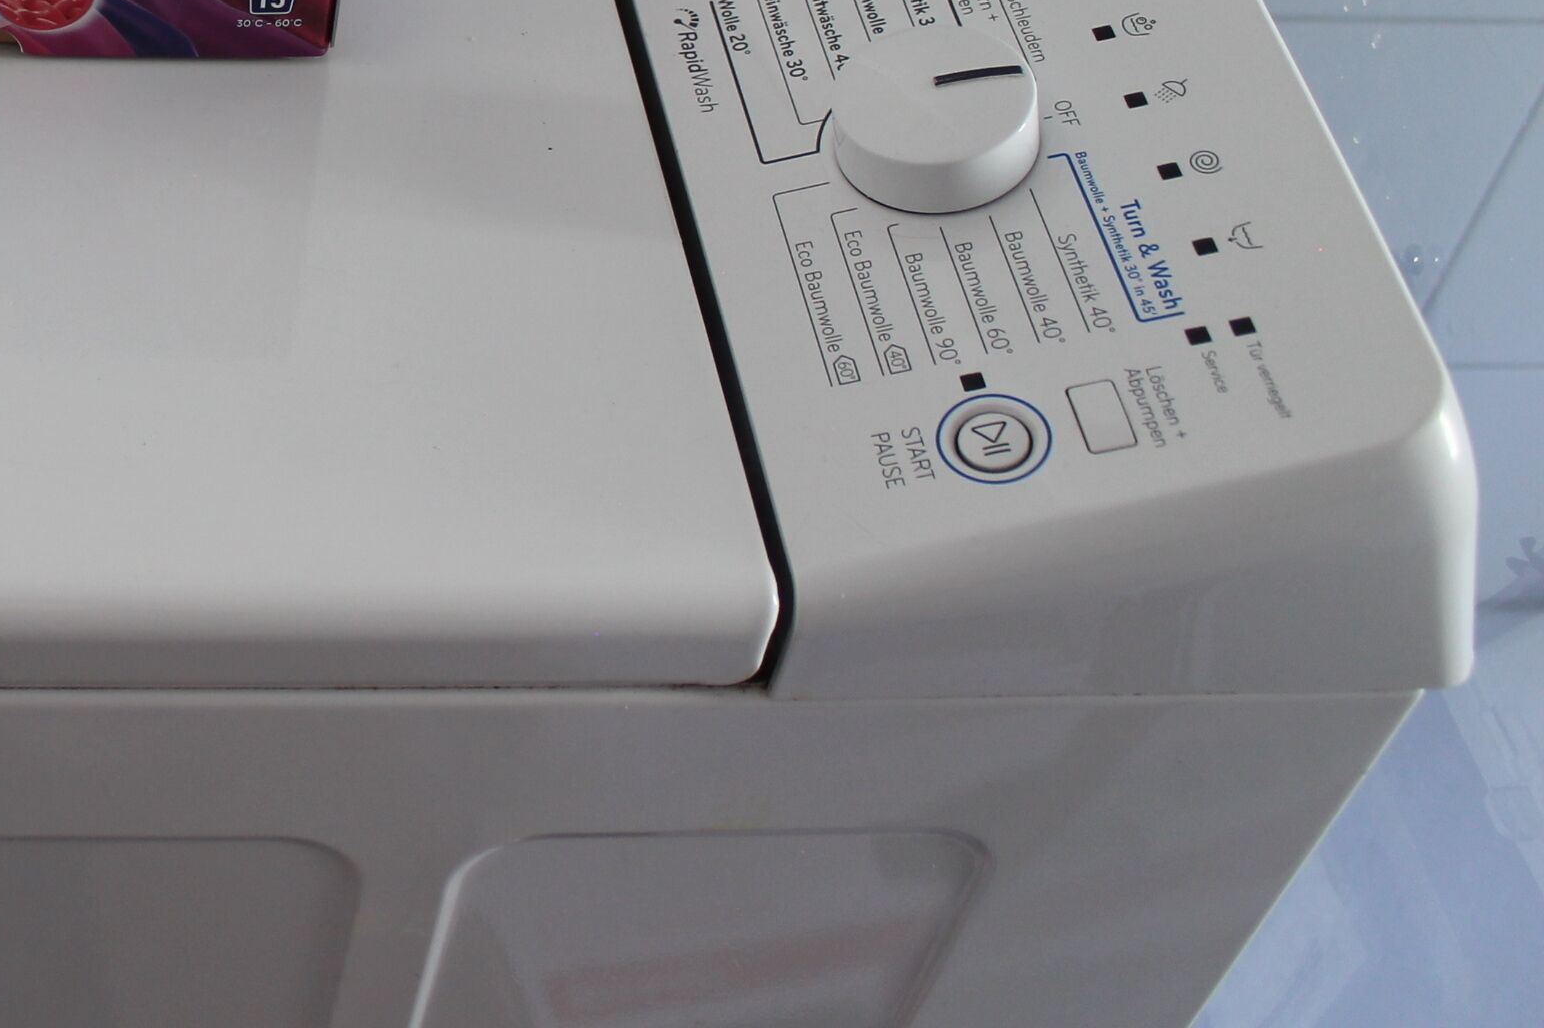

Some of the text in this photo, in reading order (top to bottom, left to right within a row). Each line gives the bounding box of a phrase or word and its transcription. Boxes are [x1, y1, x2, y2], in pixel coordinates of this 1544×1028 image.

[678, 30, 719, 113] RapidWash
[729, 33, 751, 56] 20°
[786, 58, 809, 82] 30°
[1054, 100, 1081, 127] OFF
[1075, 151, 1105, 205] Baumwolle
[1102, 214, 1132, 263] Synthetik
[1133, 282, 1145, 298] in
[1120, 199, 1182, 310] Turn & Wash
[794, 240, 844, 354] Eco Baumwolle
[844, 230, 895, 343] Eco Baumwolle
[904, 253, 962, 366] Baumwolle 90°
[954, 241, 1014, 355] Baumwolle 60°
[1004, 231, 1066, 343] Baumwolle 40°
[1056, 234, 1116, 332] Synthetik 40°
[1124, 367, 1167, 448] Abpumpen
[1145, 365, 1179, 426] Löschen
[1201, 349, 1229, 394] Service
[870, 431, 906, 490] PAUSE
[900, 426, 936, 481] START
